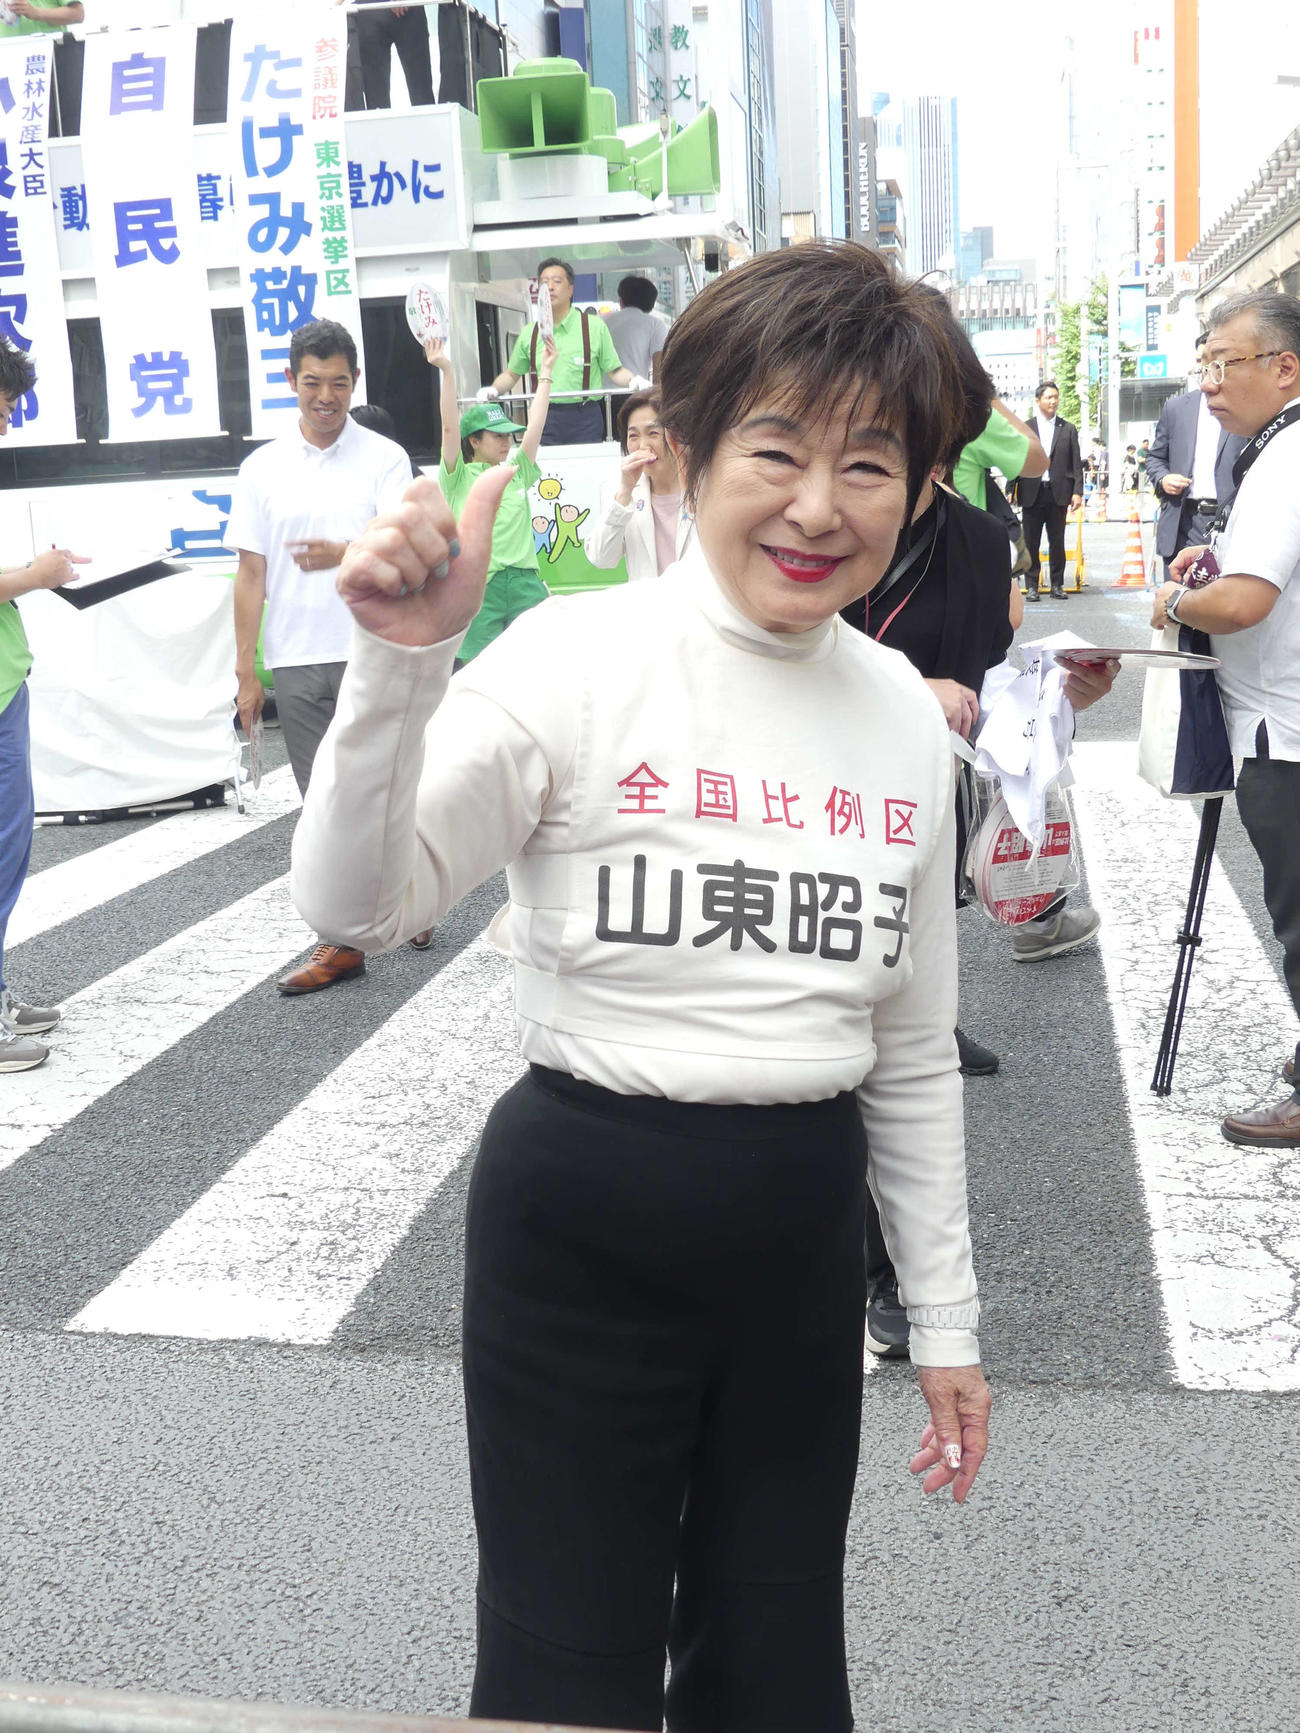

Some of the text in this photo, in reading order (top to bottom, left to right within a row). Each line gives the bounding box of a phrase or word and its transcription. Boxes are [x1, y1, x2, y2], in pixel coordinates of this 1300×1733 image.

[19, 54, 47, 198] 農林水産大臣
[671, 23, 692, 133] 教文
[53, 183, 90, 232] 動
[311, 37, 353, 297] 参議院 東京選挙区
[108, 51, 193, 419] 自民党
[1255, 414, 1287, 450] SONY
[617, 761, 918, 847] 全国比例区
[998, 827, 1055, 857] 山昭子
[596, 854, 910, 969] 山東昭子
